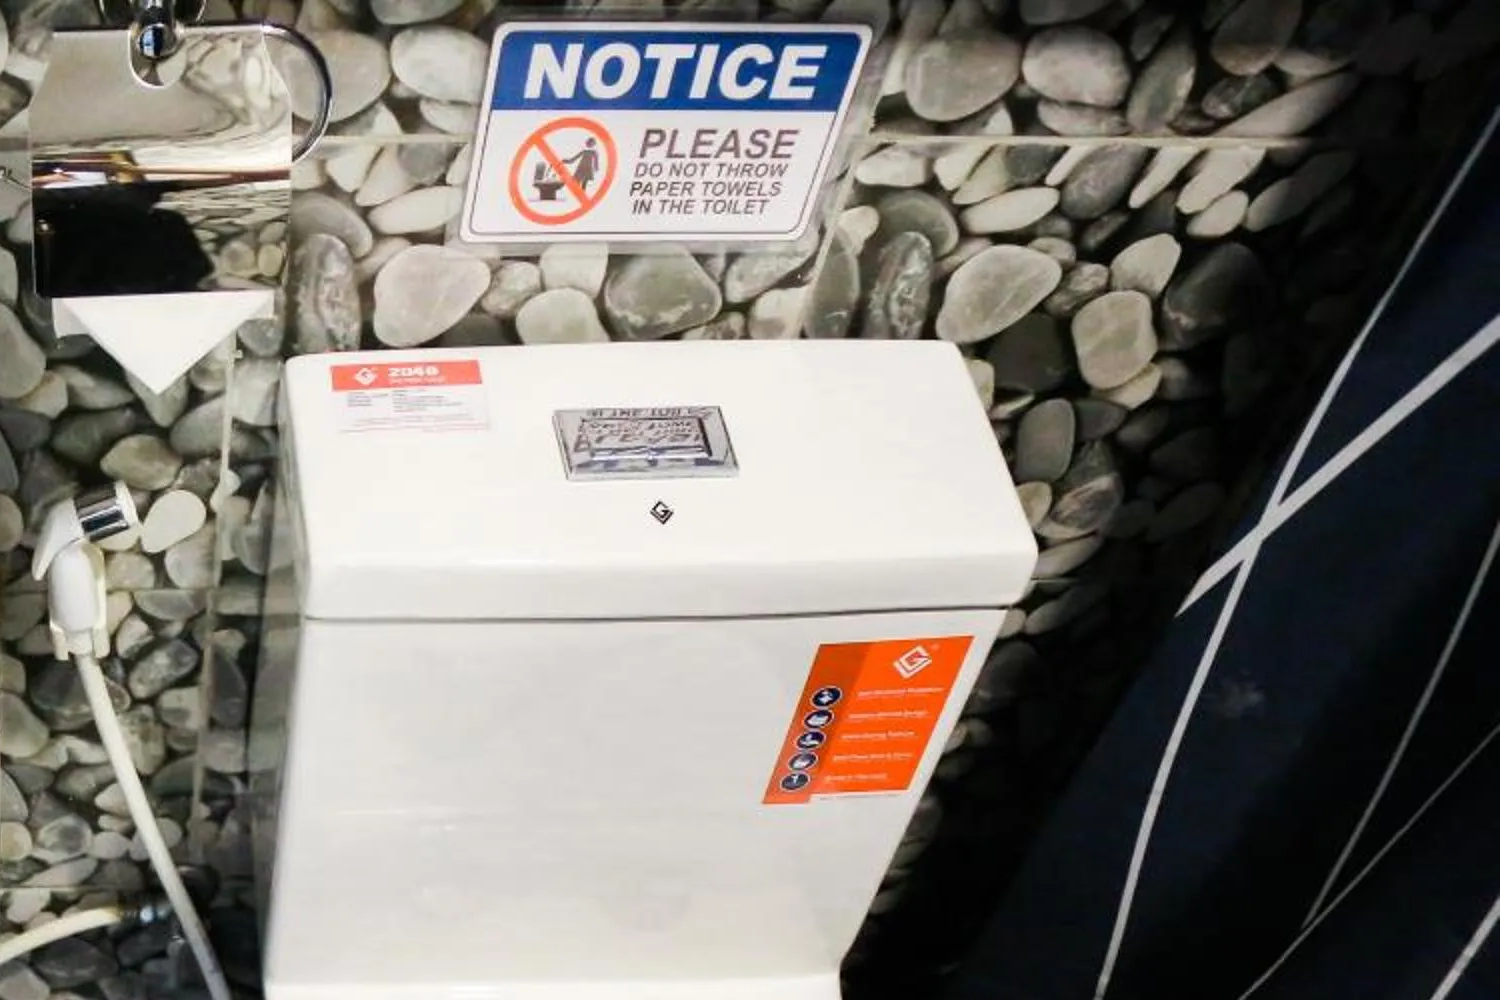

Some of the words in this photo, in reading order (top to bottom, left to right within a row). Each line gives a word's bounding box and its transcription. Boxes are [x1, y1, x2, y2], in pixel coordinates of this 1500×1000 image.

[524, 42, 829, 100] NOTICE
[639, 128, 800, 159] PLEASE
[634, 163, 663, 178] DO
[668, 163, 710, 177] NOT
[716, 163, 789, 178] THROW
[629, 181, 695, 197] PAPER
[702, 181, 783, 197] TOWELS
[631, 199, 653, 214] IN
[659, 199, 697, 214] THE
[702, 199, 770, 215] TOILET
